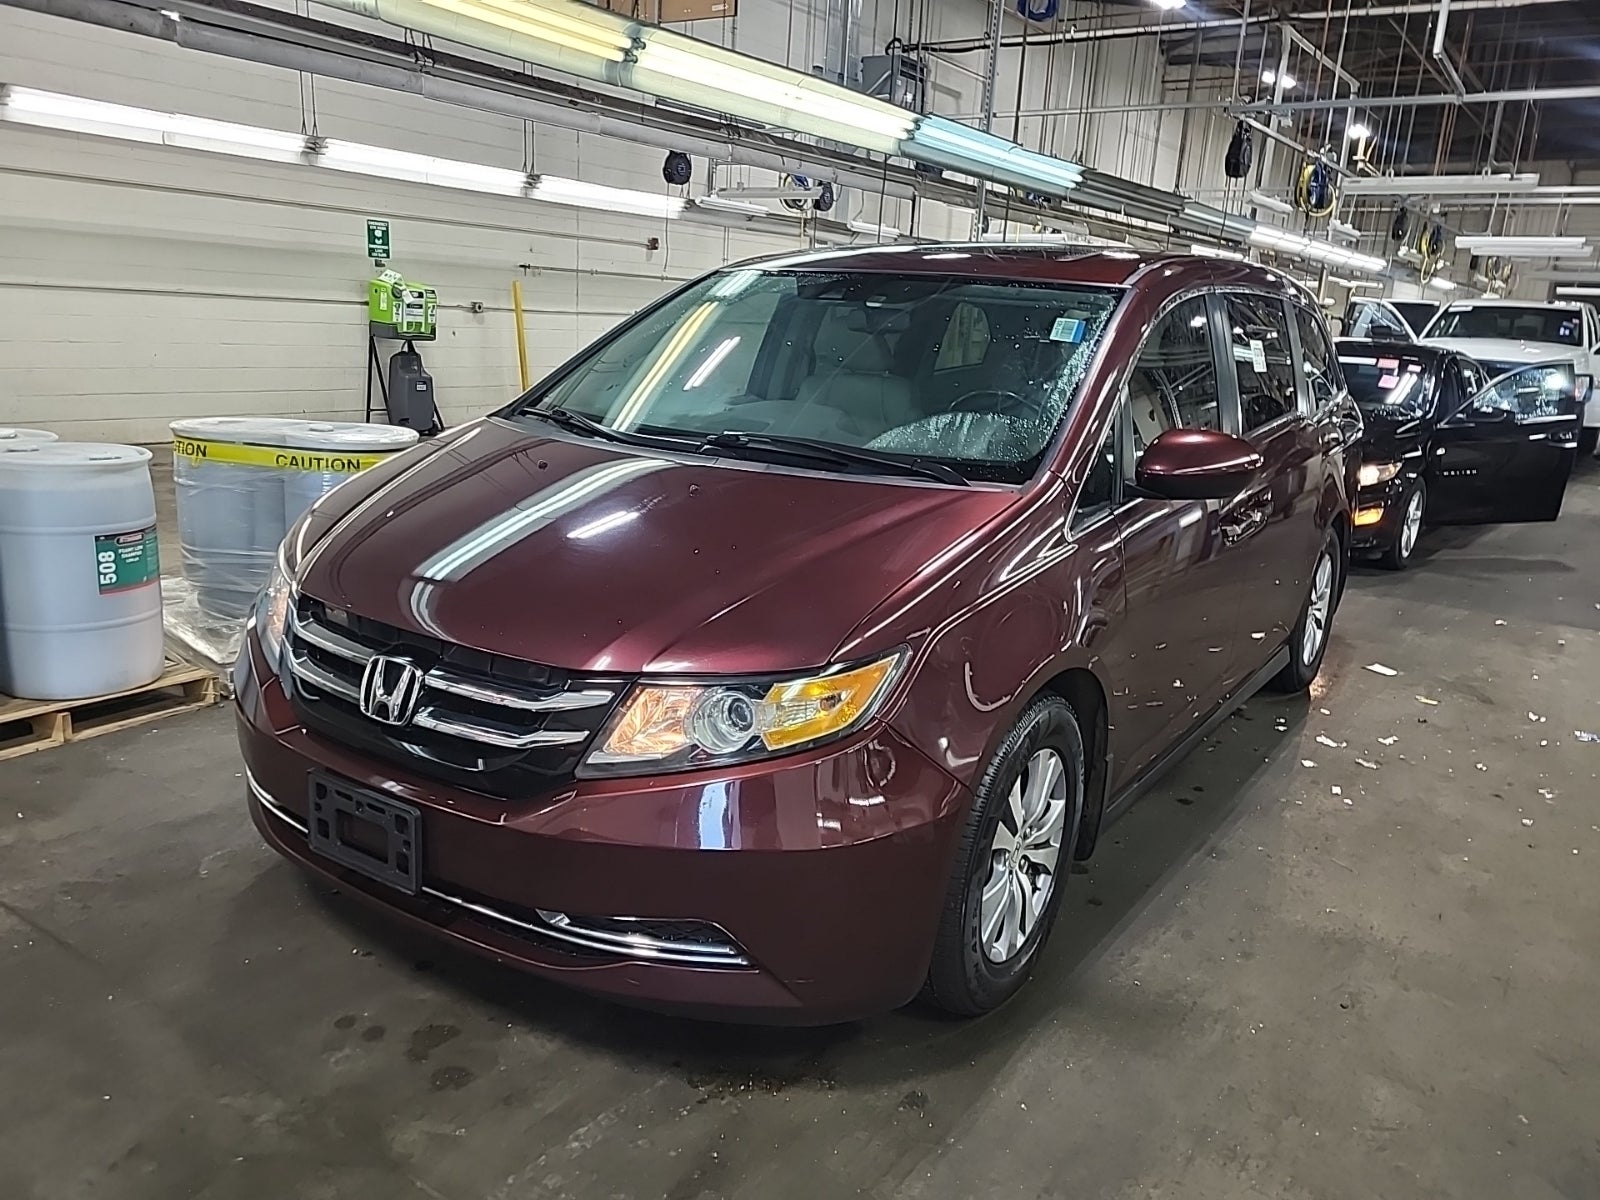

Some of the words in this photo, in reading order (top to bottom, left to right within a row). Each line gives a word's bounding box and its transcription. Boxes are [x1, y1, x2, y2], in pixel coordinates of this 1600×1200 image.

[174, 440, 207, 457] TION
[275, 454, 361, 472] CAUTION
[98, 551, 117, 585] 508
